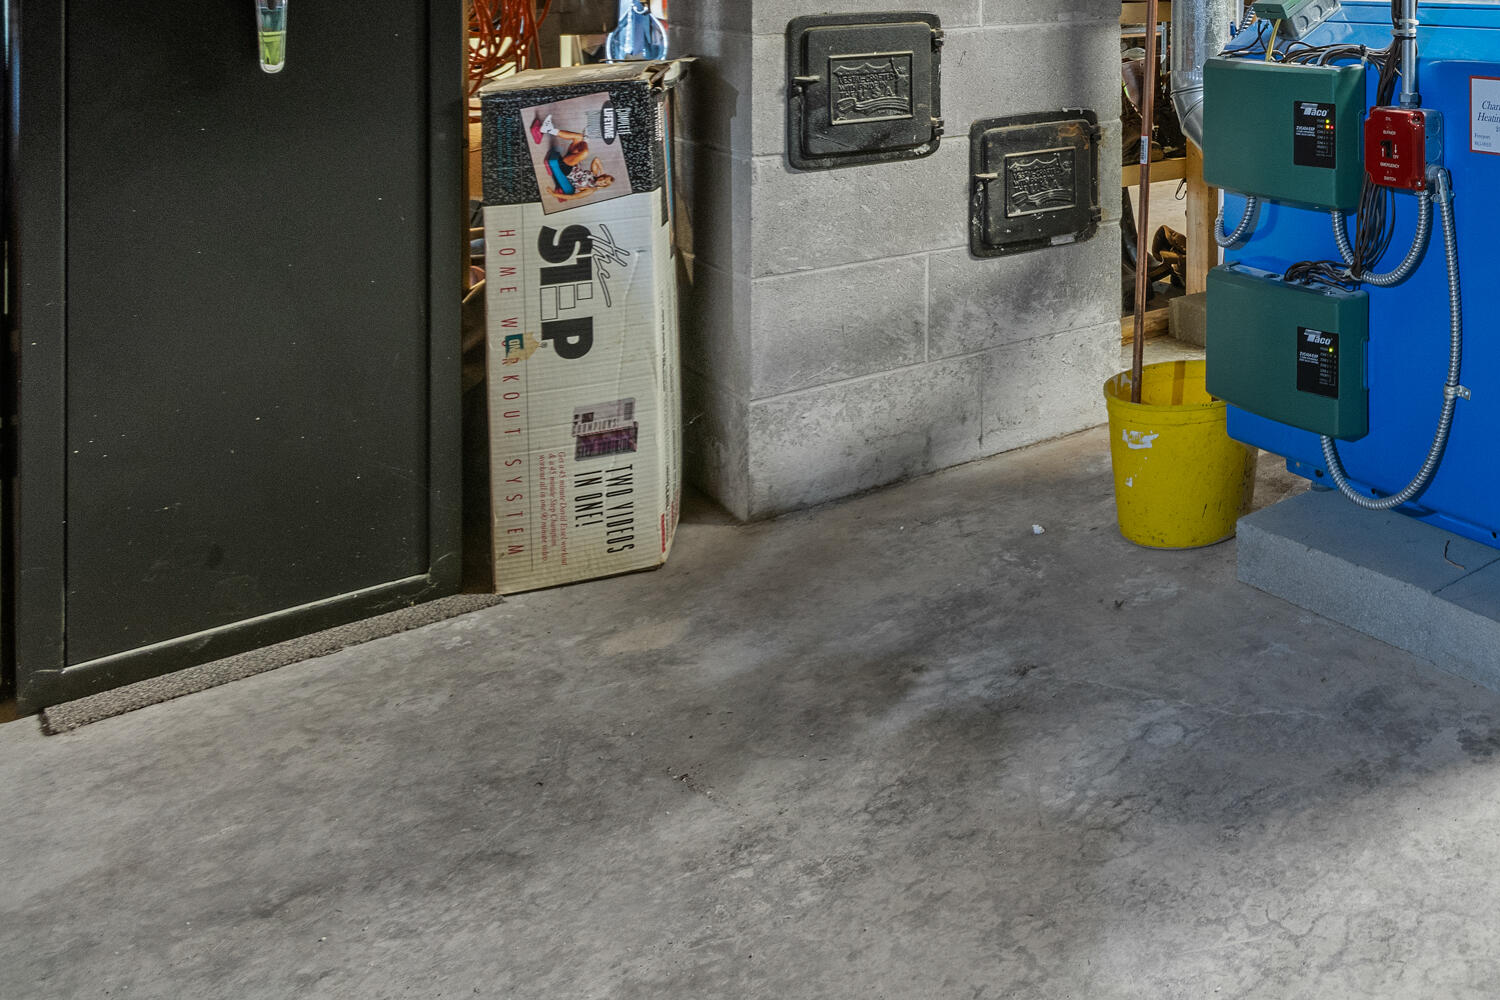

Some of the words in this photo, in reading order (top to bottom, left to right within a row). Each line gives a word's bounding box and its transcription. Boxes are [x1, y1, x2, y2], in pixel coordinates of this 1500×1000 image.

[603, 107, 614, 139] LIFETIME
[1300, 102, 1328, 117] Taco
[1380, 161, 1400, 169] EMERGENCY
[498, 229, 517, 294] HOME
[588, 223, 631, 308] The
[537, 224, 594, 360] STEP
[1303, 328, 1331, 345] Taco
[501, 317, 521, 434] WRKOUT
[539, 455, 548, 480] workout
[559, 470, 566, 478] 45
[574, 470, 603, 488] IN
[605, 464, 633, 498] TWO
[504, 458, 525, 556] SYSTEM
[559, 502, 567, 522] David
[575, 492, 604, 528] ONE!
[606, 501, 635, 554] VIDEOS
